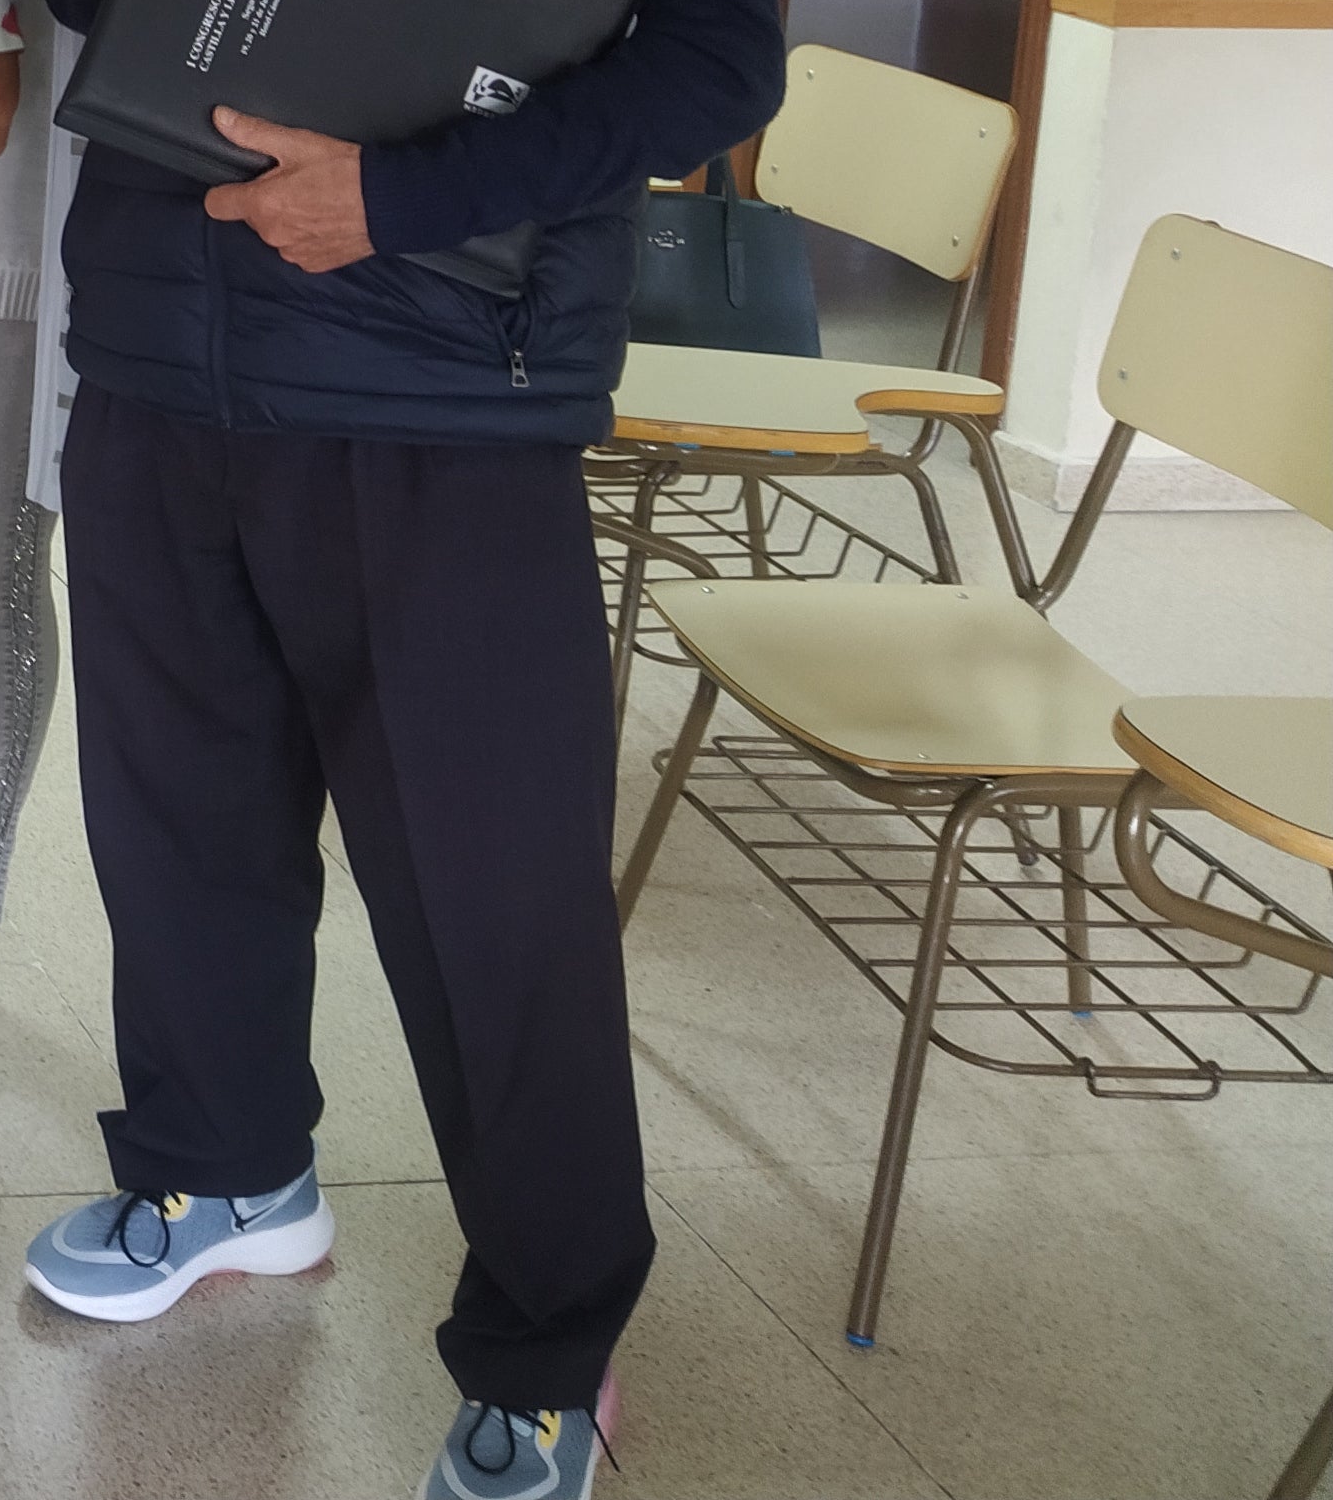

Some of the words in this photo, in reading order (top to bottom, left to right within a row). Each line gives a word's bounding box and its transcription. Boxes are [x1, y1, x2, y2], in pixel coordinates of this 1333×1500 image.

[199, 21, 226, 72] CASTILLA
[220, 10, 229, 18] Y
[186, 60, 196, 68] I
